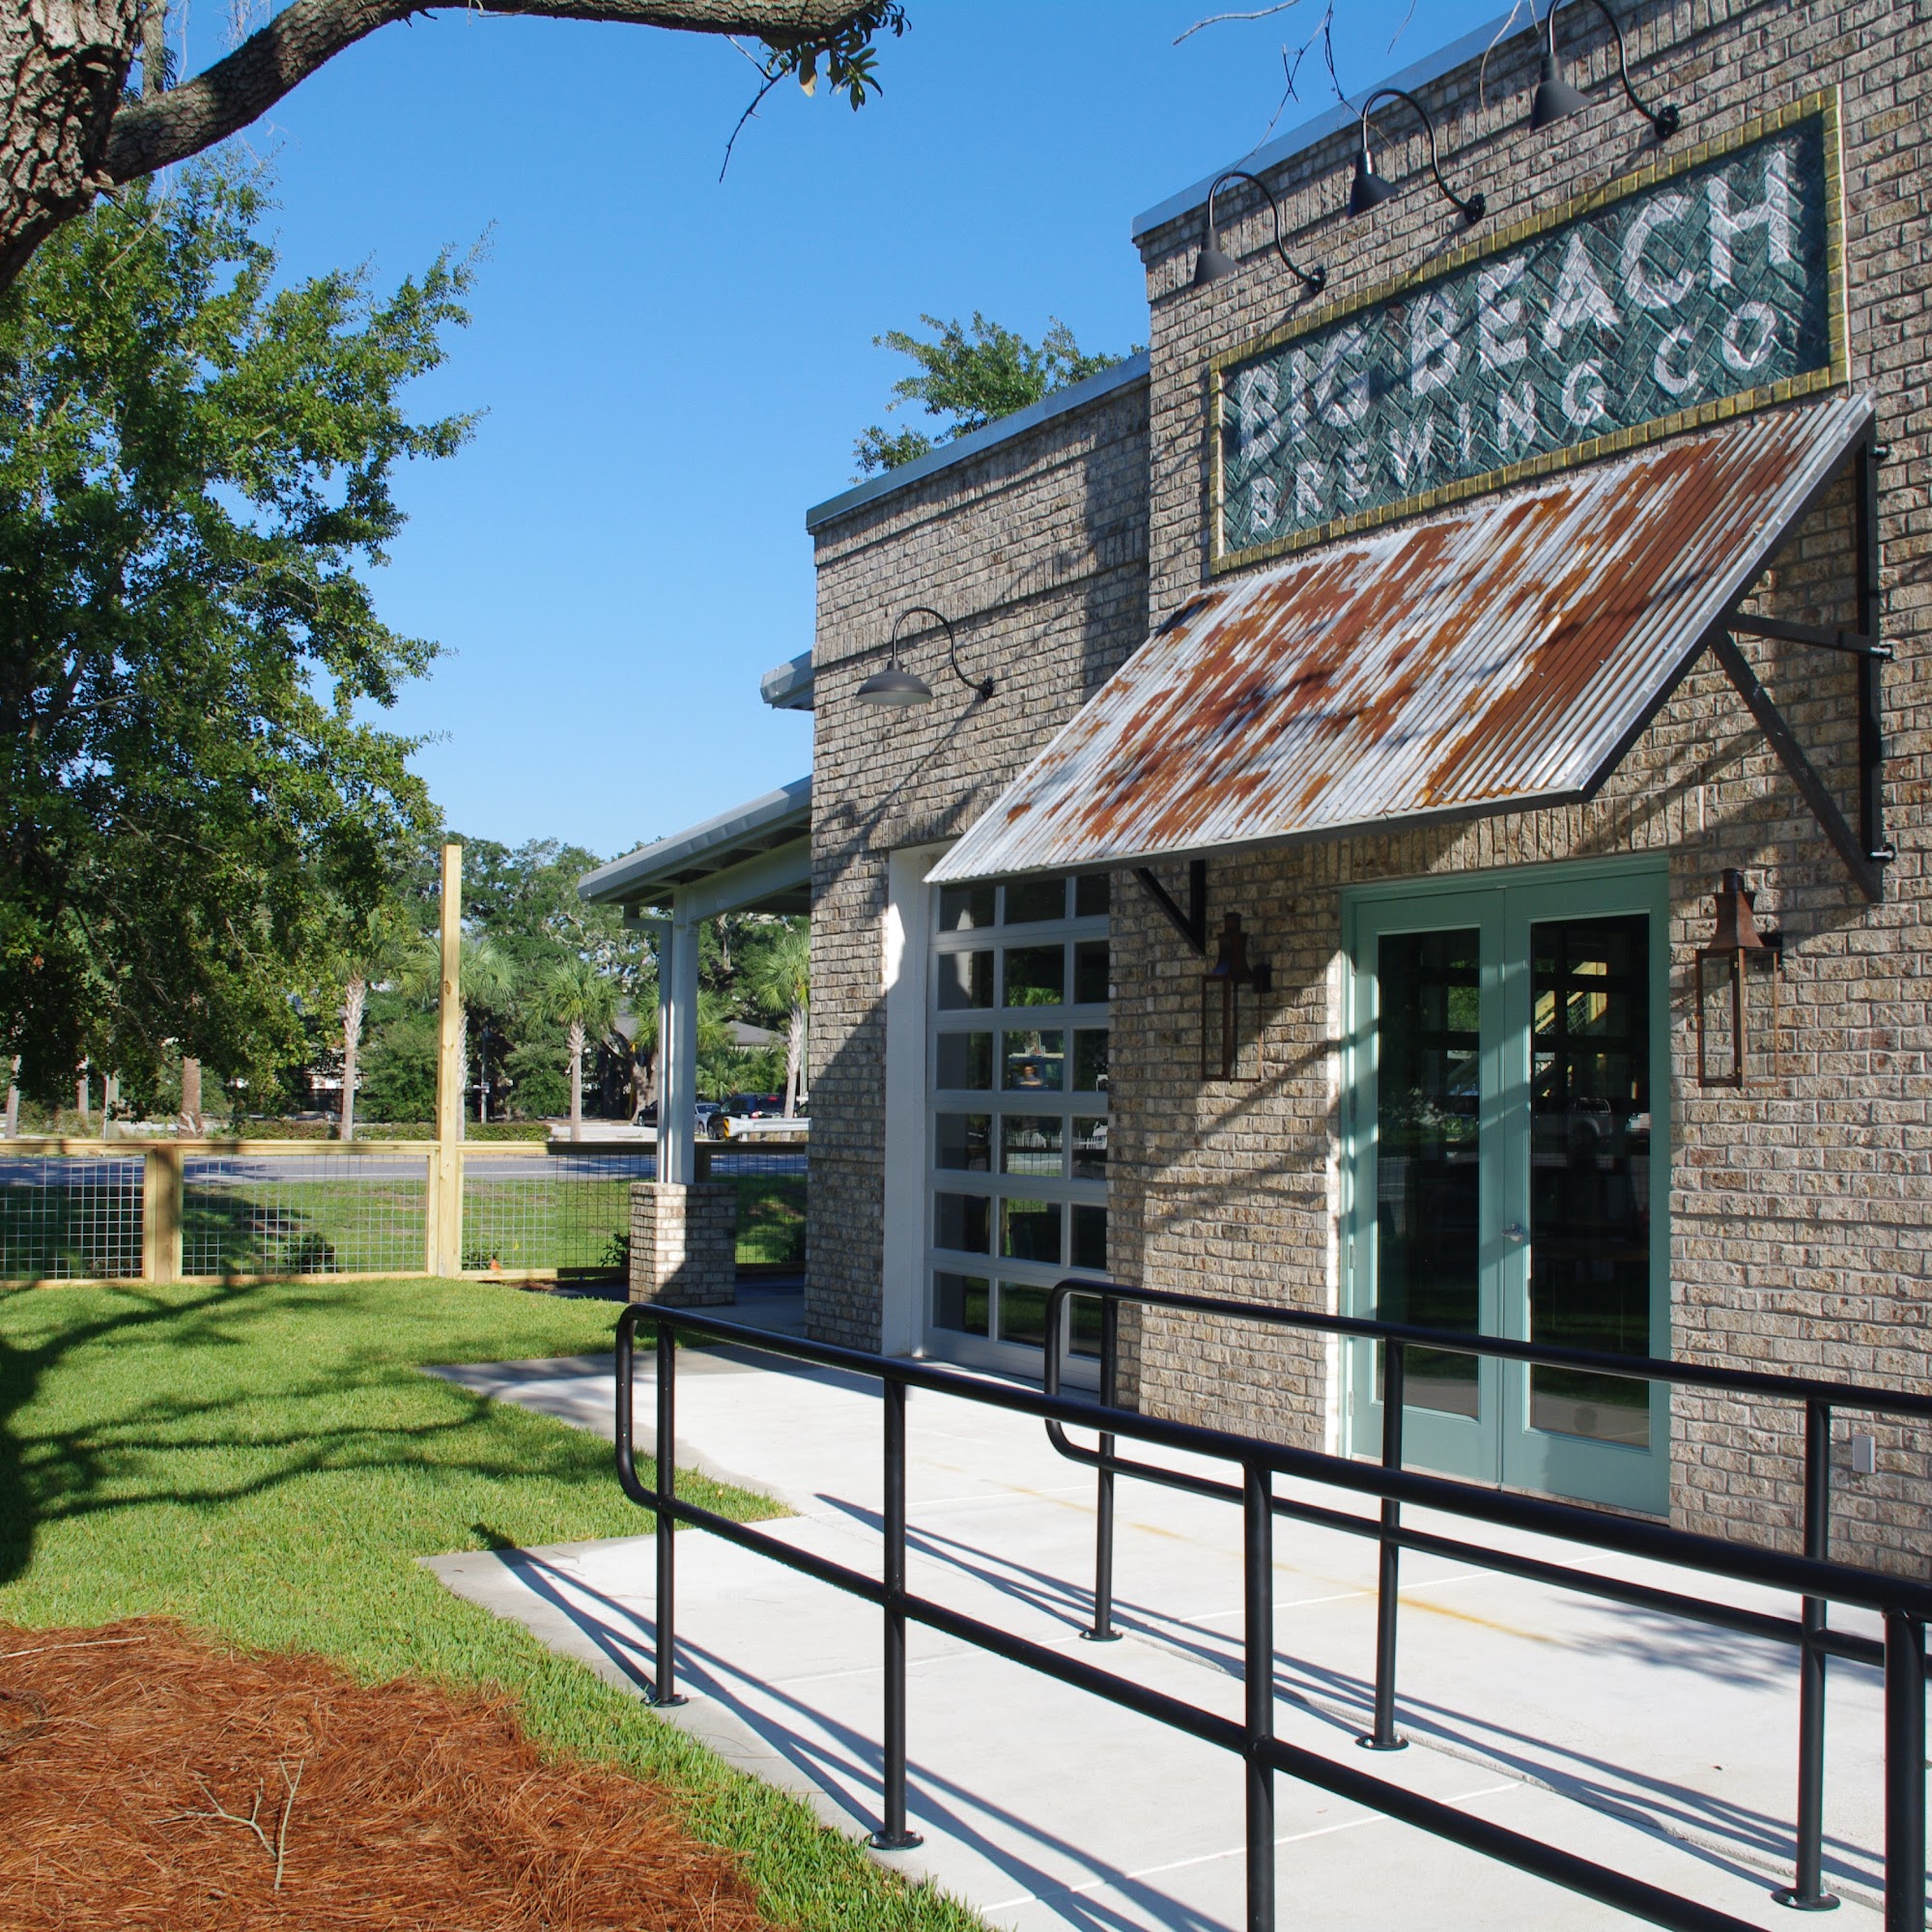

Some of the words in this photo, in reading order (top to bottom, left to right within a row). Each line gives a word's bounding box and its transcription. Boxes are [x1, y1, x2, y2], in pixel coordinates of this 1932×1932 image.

[1239, 327, 1370, 458] BIG
[1411, 151, 1787, 398] BEACH
[1251, 359, 1605, 532] BREWING
[1654, 301, 1776, 395] CO
